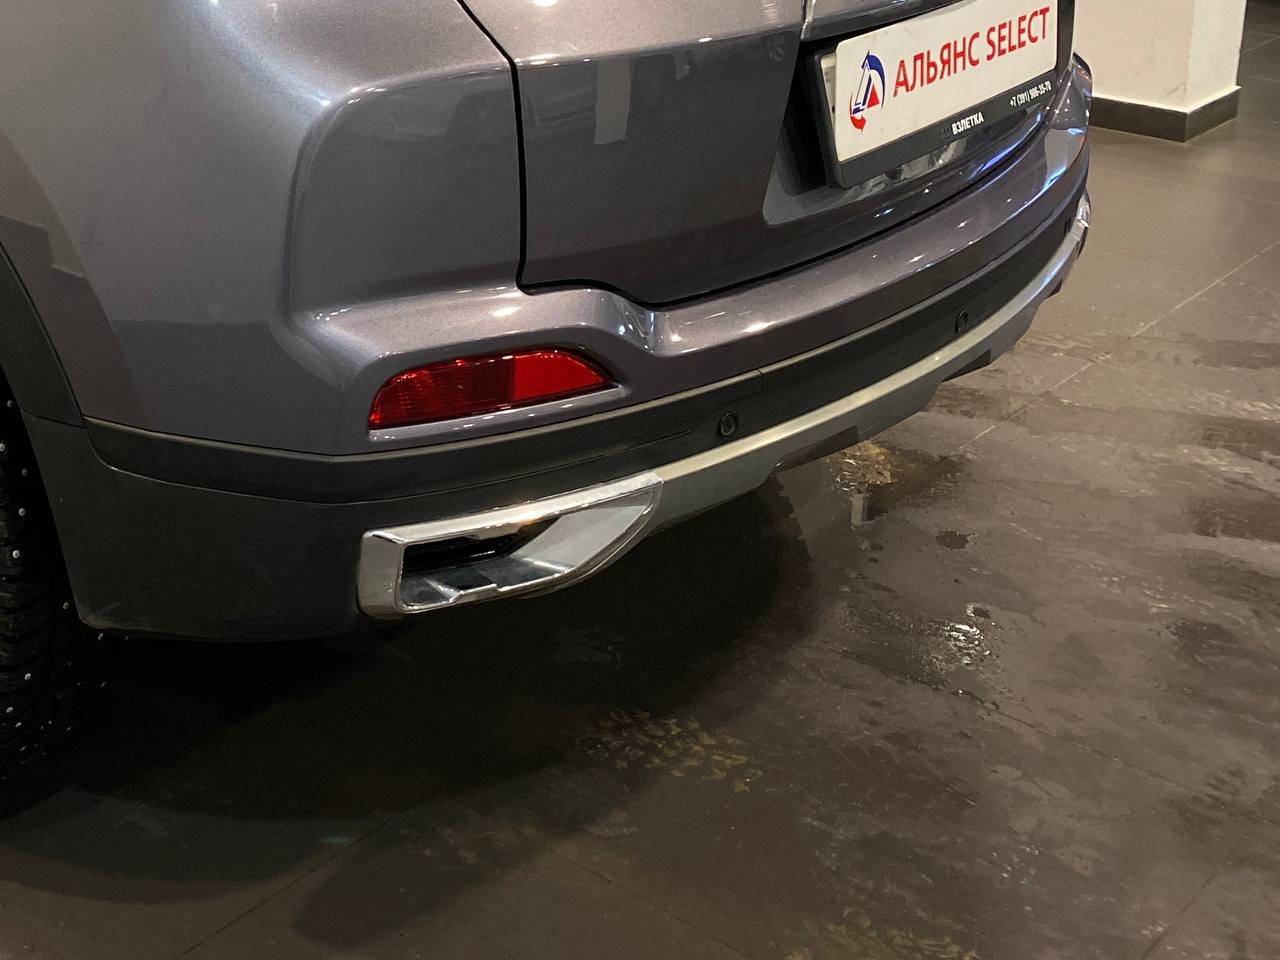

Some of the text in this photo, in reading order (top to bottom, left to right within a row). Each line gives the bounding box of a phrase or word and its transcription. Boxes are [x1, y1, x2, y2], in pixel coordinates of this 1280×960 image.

[893, 6, 1050, 97] АЛЬЯНС SELECT
[951, 111, 984, 135] ВЗЛЕТКА
